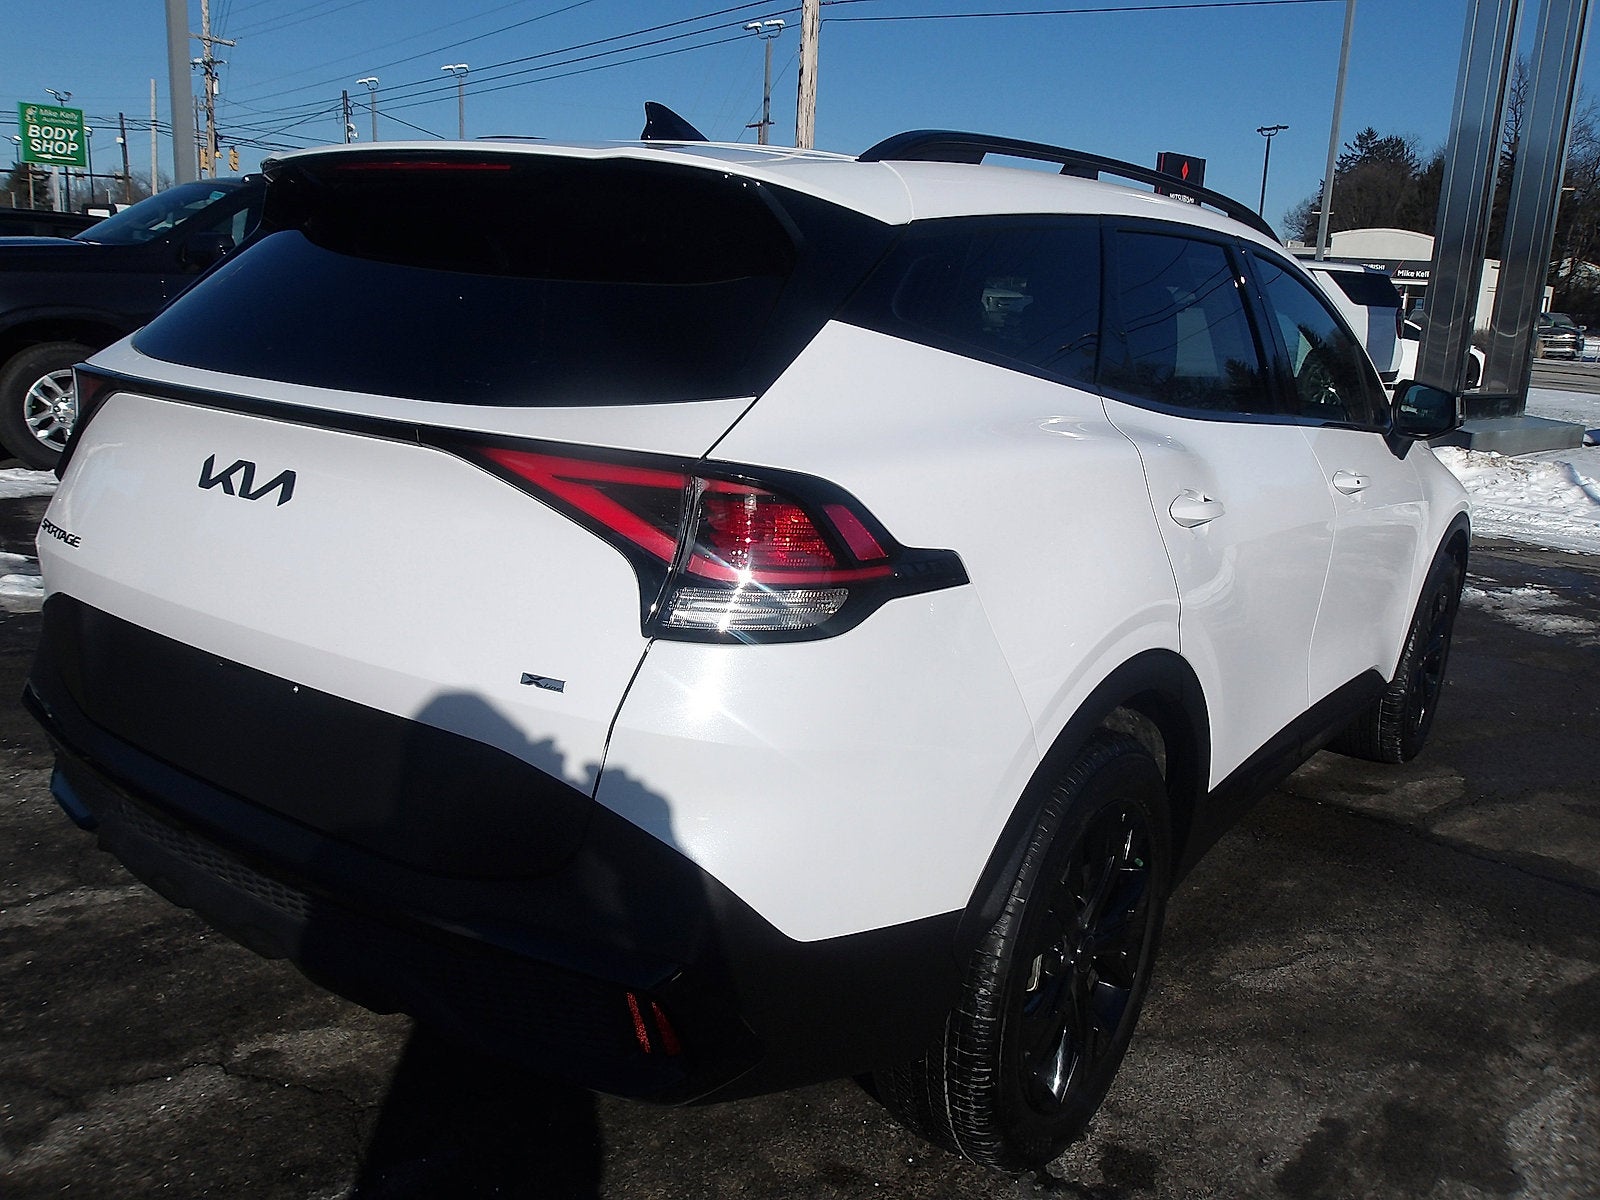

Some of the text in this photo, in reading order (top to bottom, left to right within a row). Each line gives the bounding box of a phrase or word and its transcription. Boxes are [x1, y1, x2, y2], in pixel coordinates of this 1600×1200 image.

[27, 124, 79, 141] BODY
[30, 138, 79, 155] SHOP
[1397, 269, 1430, 278] Mike Kell
[198, 453, 296, 507] KIA
[41, 517, 82, 549] SPORTAGE
